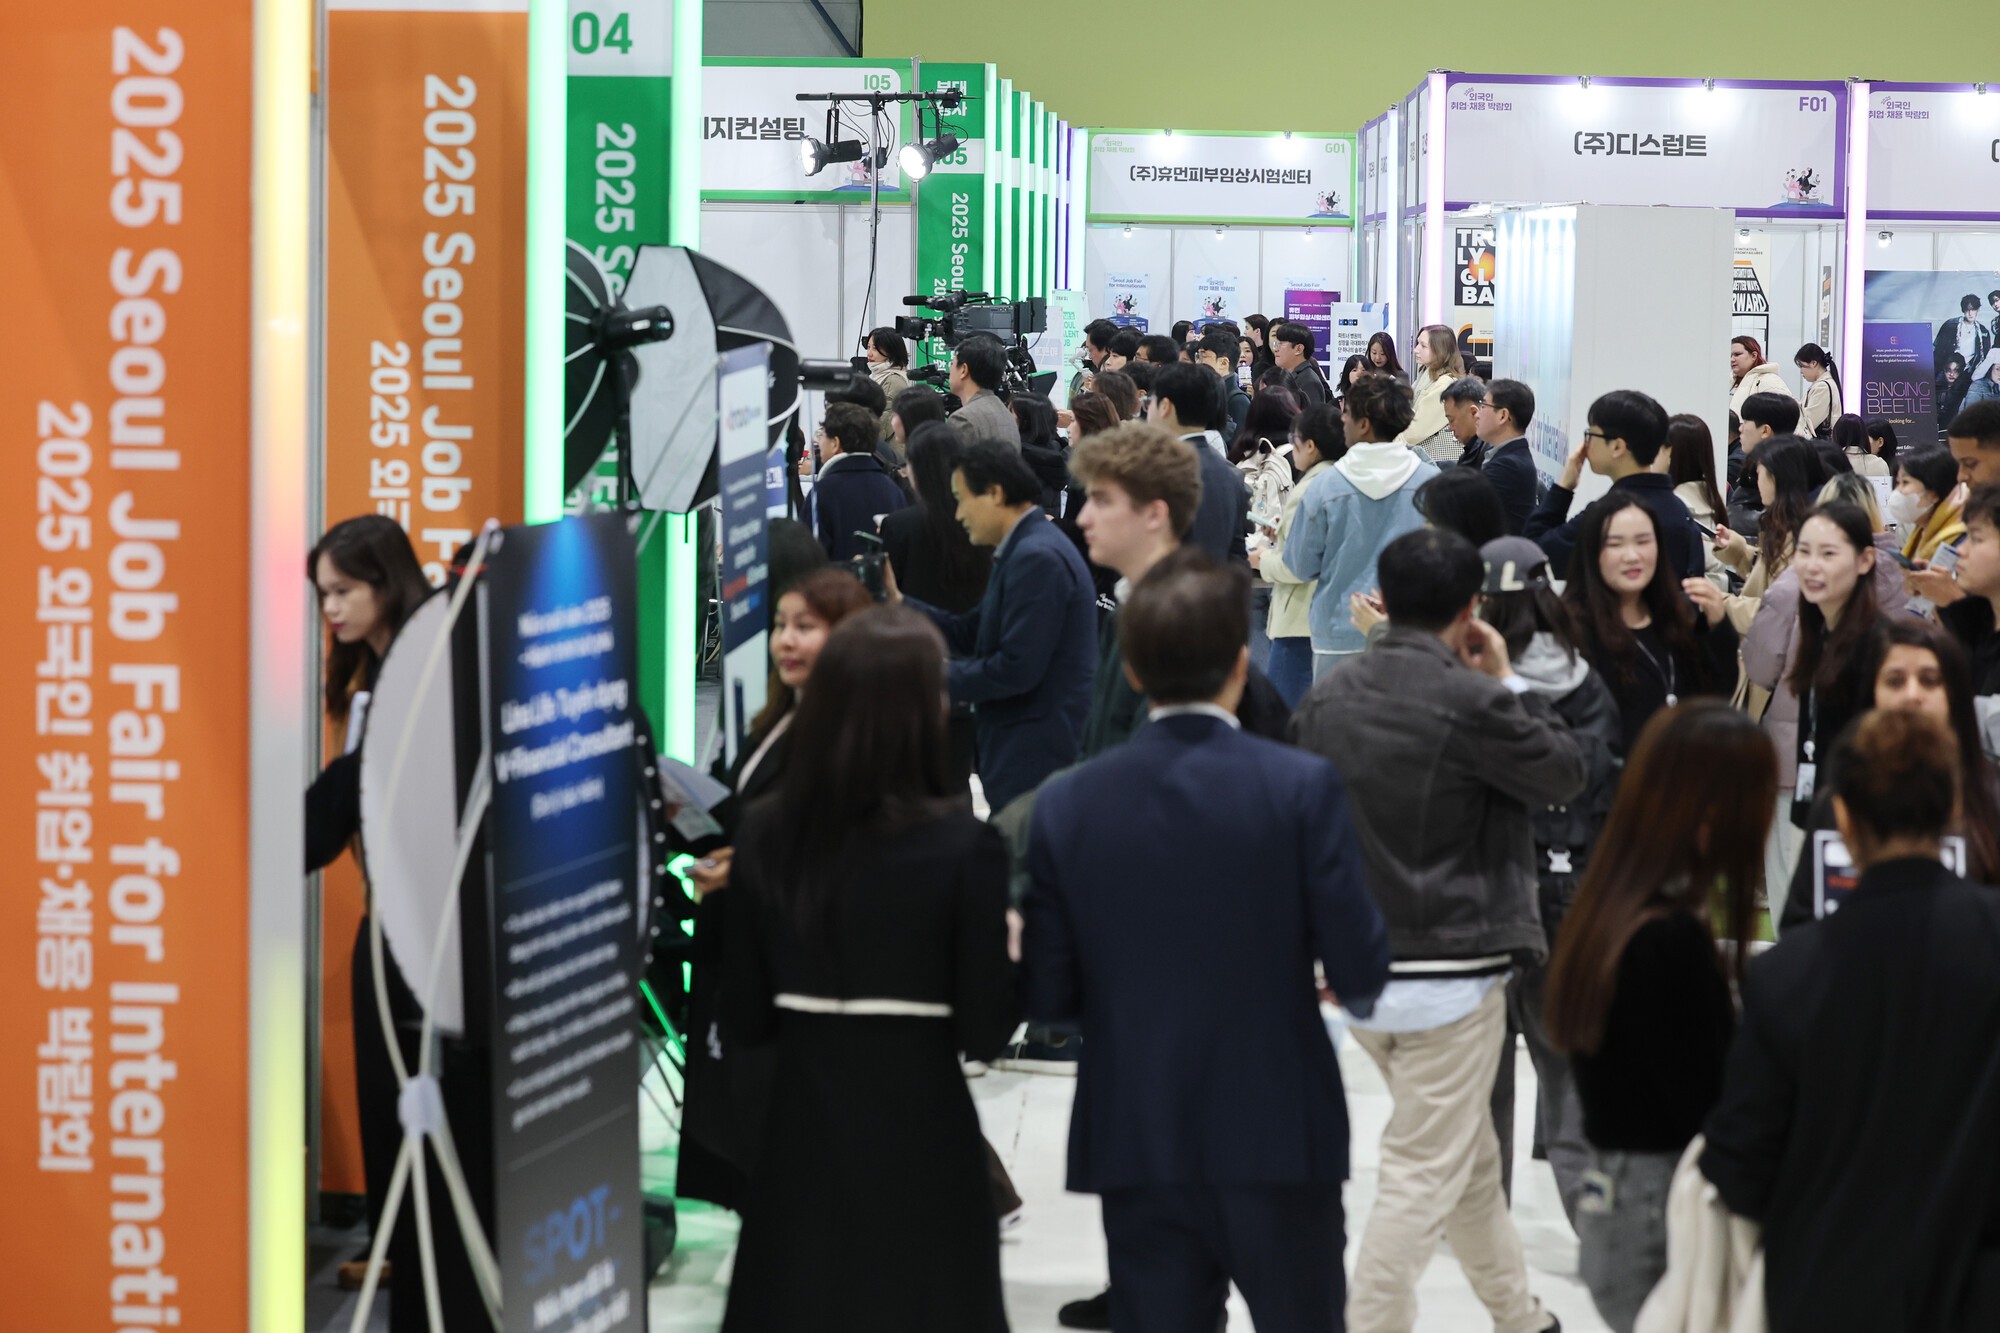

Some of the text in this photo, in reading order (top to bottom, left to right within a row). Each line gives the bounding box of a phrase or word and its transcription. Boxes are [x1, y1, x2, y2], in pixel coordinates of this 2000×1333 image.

[1469, 93, 1494, 101] 외국인
[1799, 96, 1827, 112] F01
[1886, 101, 1911, 110] 외국인
[1488, 103, 1512, 111] 박람회
[1905, 111, 1930, 119] 박람회
[423, 74, 477, 218] 2025
[1325, 143, 1345, 153] G01
[1574, 131, 1707, 157] (주)디스럽트
[595, 123, 636, 233] 2025
[1130, 165, 1311, 184] (주)휴먼피부임상시험센터
[952, 192, 969, 239] 2025
[1457, 247, 1485, 265] LY
[421, 232, 475, 390] Seoul
[369, 340, 412, 449] 2025
[1865, 381, 1930, 397] SINGING
[1866, 398, 1931, 414] BEETLE
[421, 405, 473, 512] Job
[108, 27, 184, 1333] 2025 Seoul Job Fair for Internati
[36, 401, 93, 1172] 2025 외국인 취업·채용 박람회
